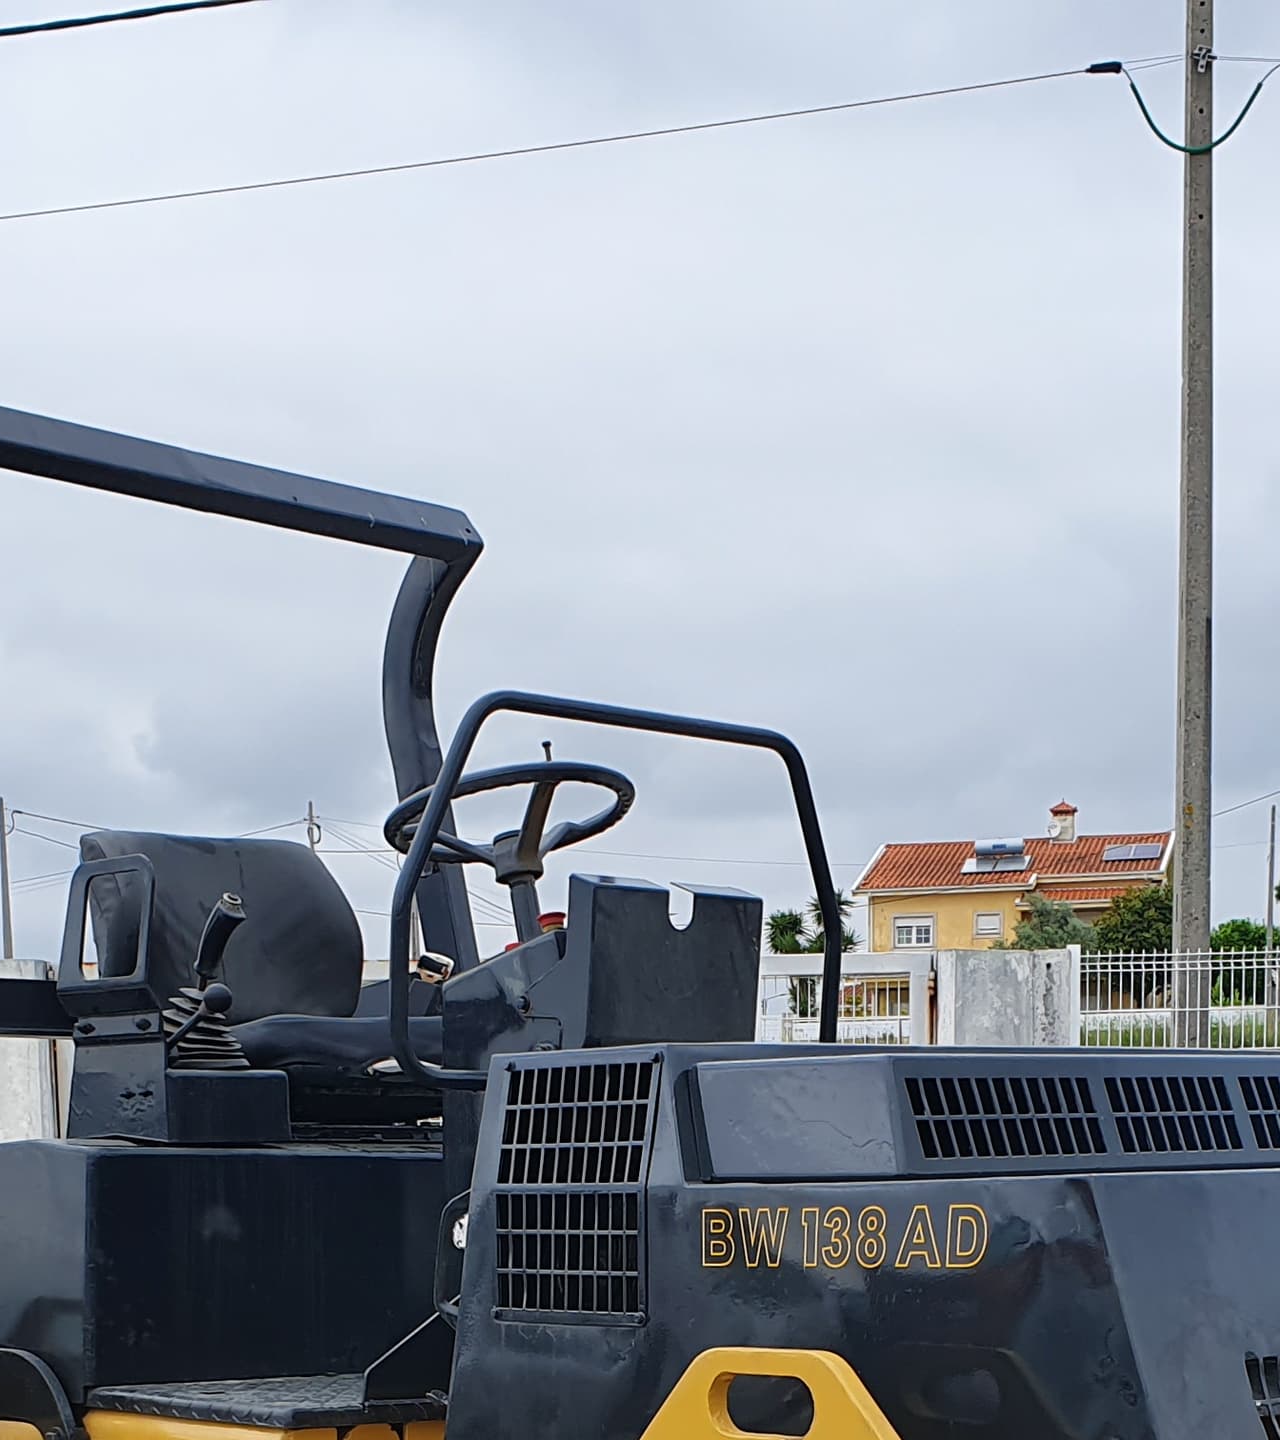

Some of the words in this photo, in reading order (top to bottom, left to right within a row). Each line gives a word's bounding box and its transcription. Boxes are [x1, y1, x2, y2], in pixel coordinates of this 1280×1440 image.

[701, 1208, 789, 1268] BW
[801, 1205, 888, 1269] 138
[894, 1204, 989, 1268] AD
